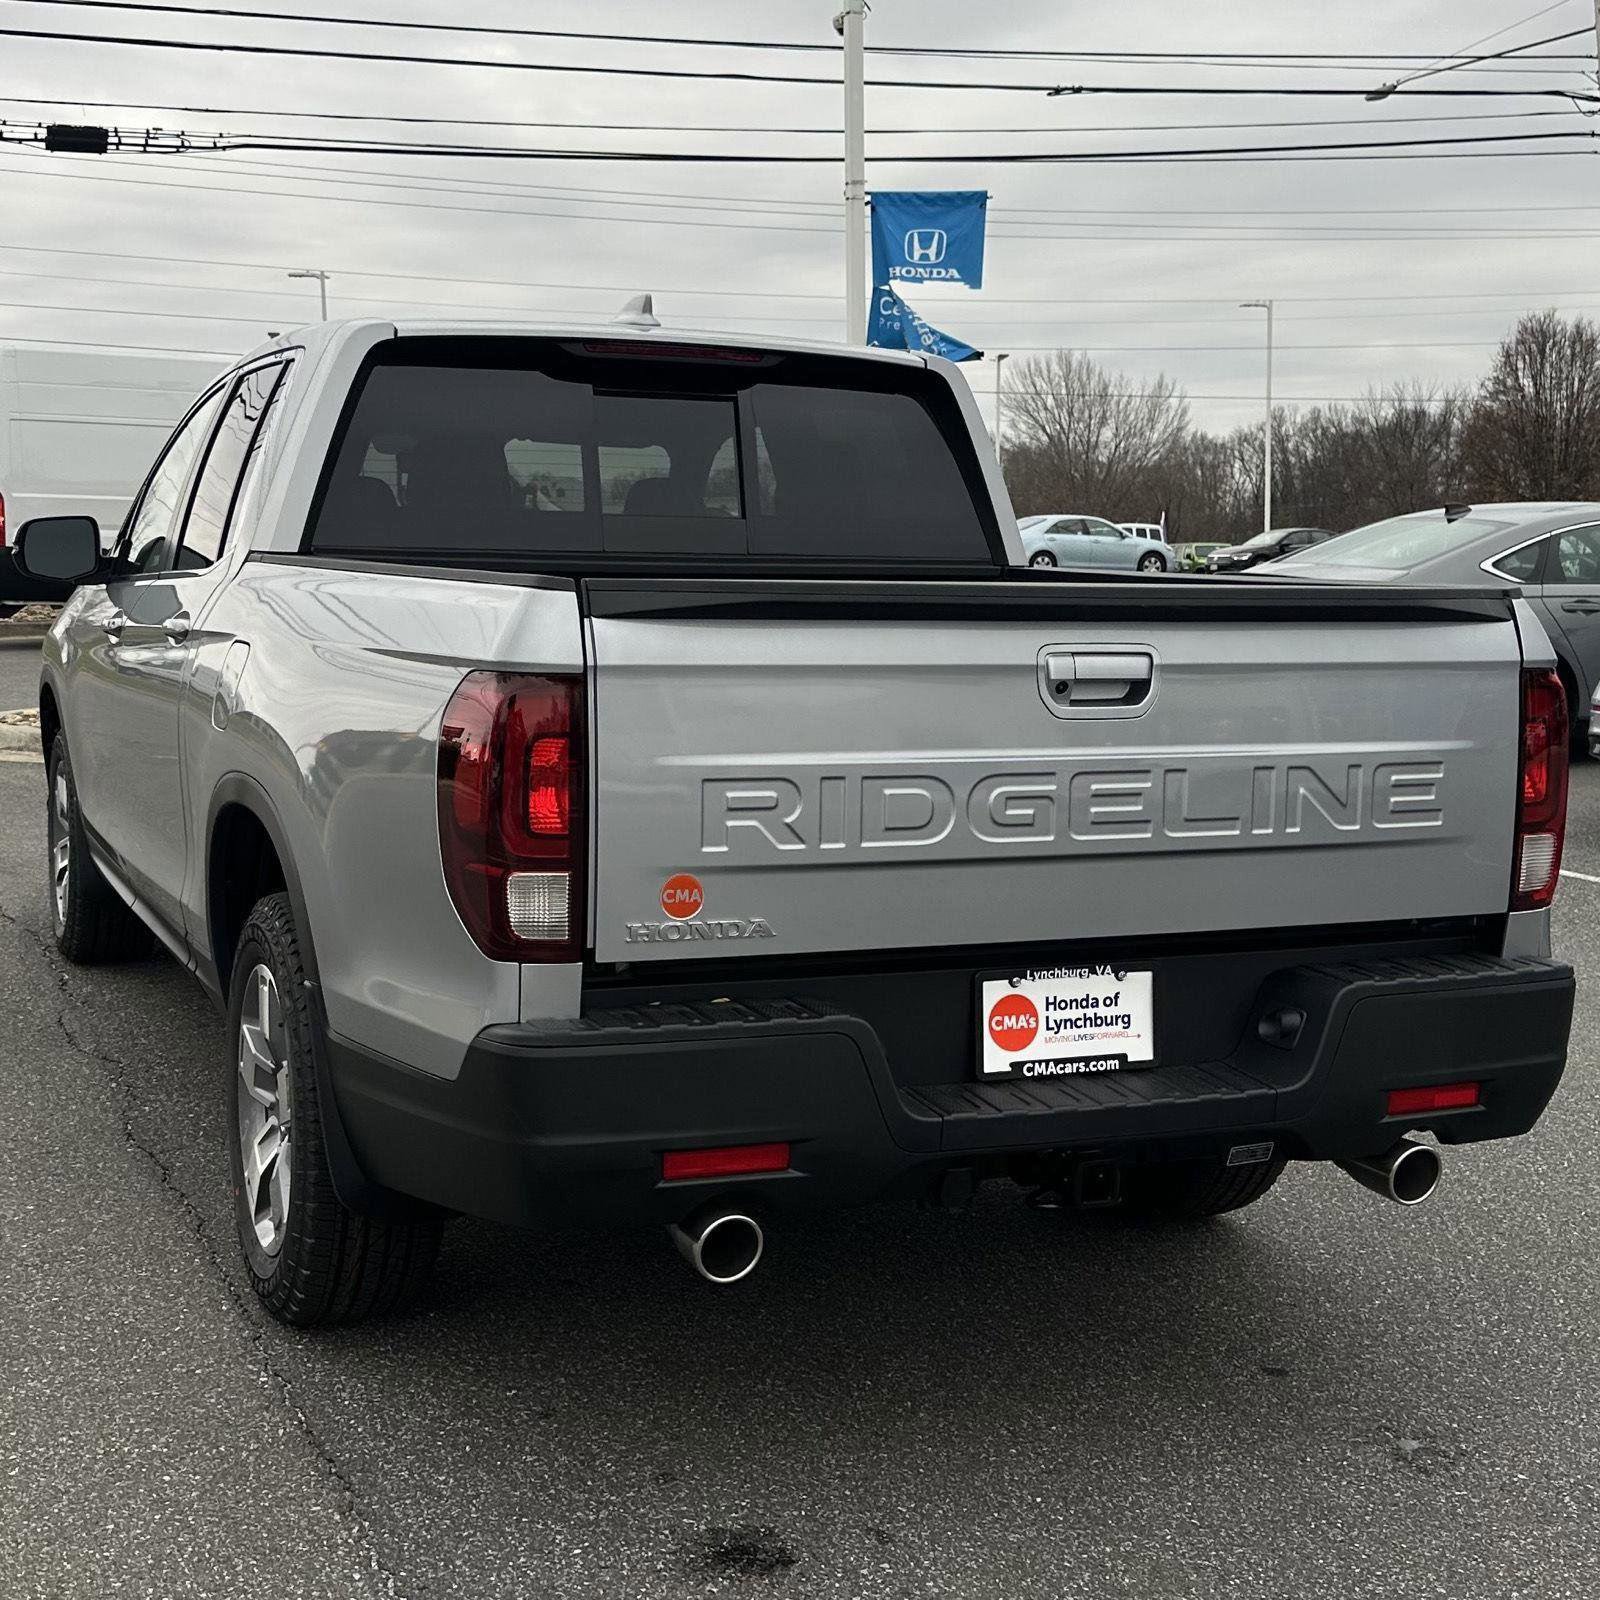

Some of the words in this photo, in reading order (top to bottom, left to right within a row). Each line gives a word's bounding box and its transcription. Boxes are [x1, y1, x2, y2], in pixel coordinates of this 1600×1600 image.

[889, 266, 961, 279] HONDA
[701, 760, 1444, 853] RIDGELINE
[662, 888, 701, 904] CMA
[625, 918, 777, 944] HONDA
[1095, 964, 1113, 977] VA
[1045, 994, 1099, 1012] Honda
[1103, 992, 1120, 1008] of
[991, 1014, 1037, 1031] CMA's
[1045, 1013, 1131, 1034] Lynchburg
[1022, 1062, 1120, 1077] CMAcars.com
